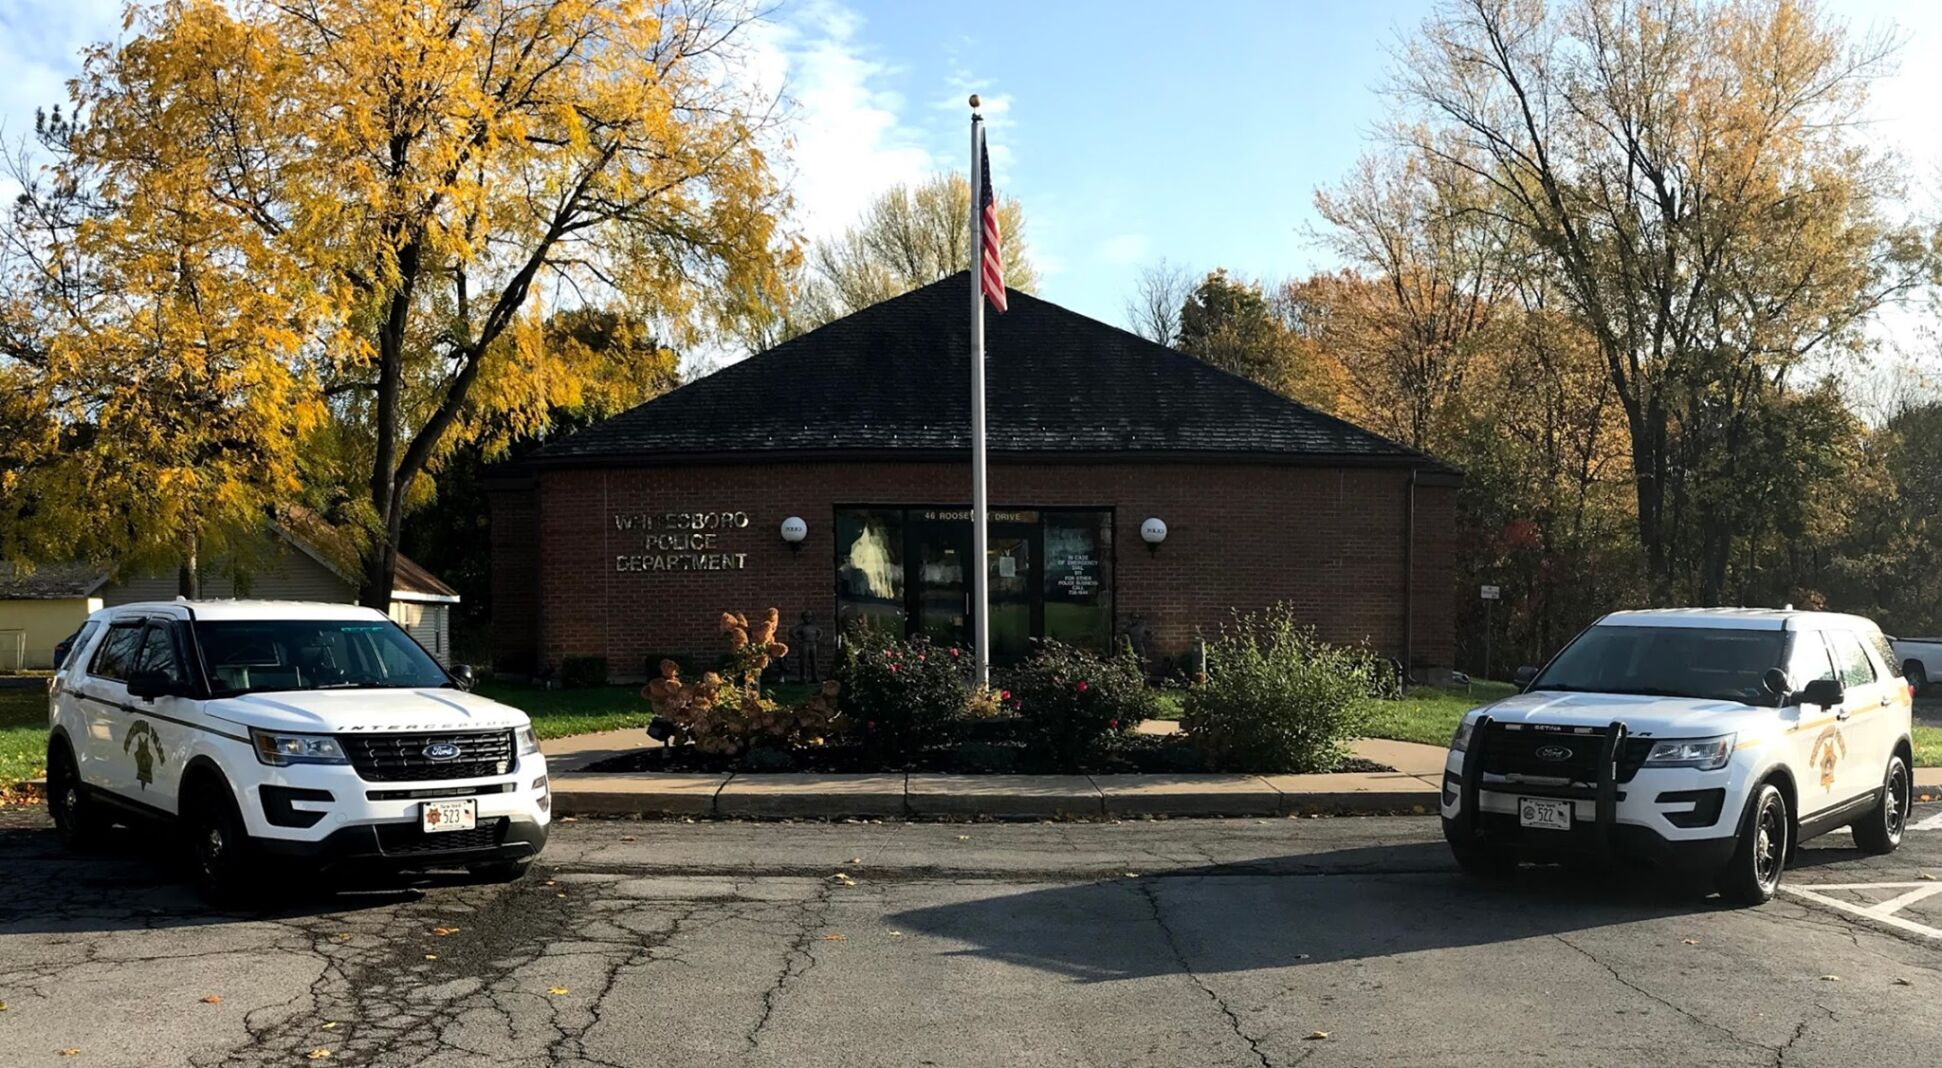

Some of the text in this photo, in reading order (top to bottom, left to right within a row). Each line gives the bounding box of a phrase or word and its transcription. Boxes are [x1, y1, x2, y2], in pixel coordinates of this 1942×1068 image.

[995, 512, 1021, 521] DRIVE
[645, 533, 717, 550] POLICE
[616, 553, 748, 572] DEPARTMENT
[337, 720, 512, 731] INTERCEPTOR
[431, 744, 453, 756] Ford
[1542, 747, 1563, 758] Ford
[443, 809, 460, 824] 523
[1538, 807, 1554, 822] 522
